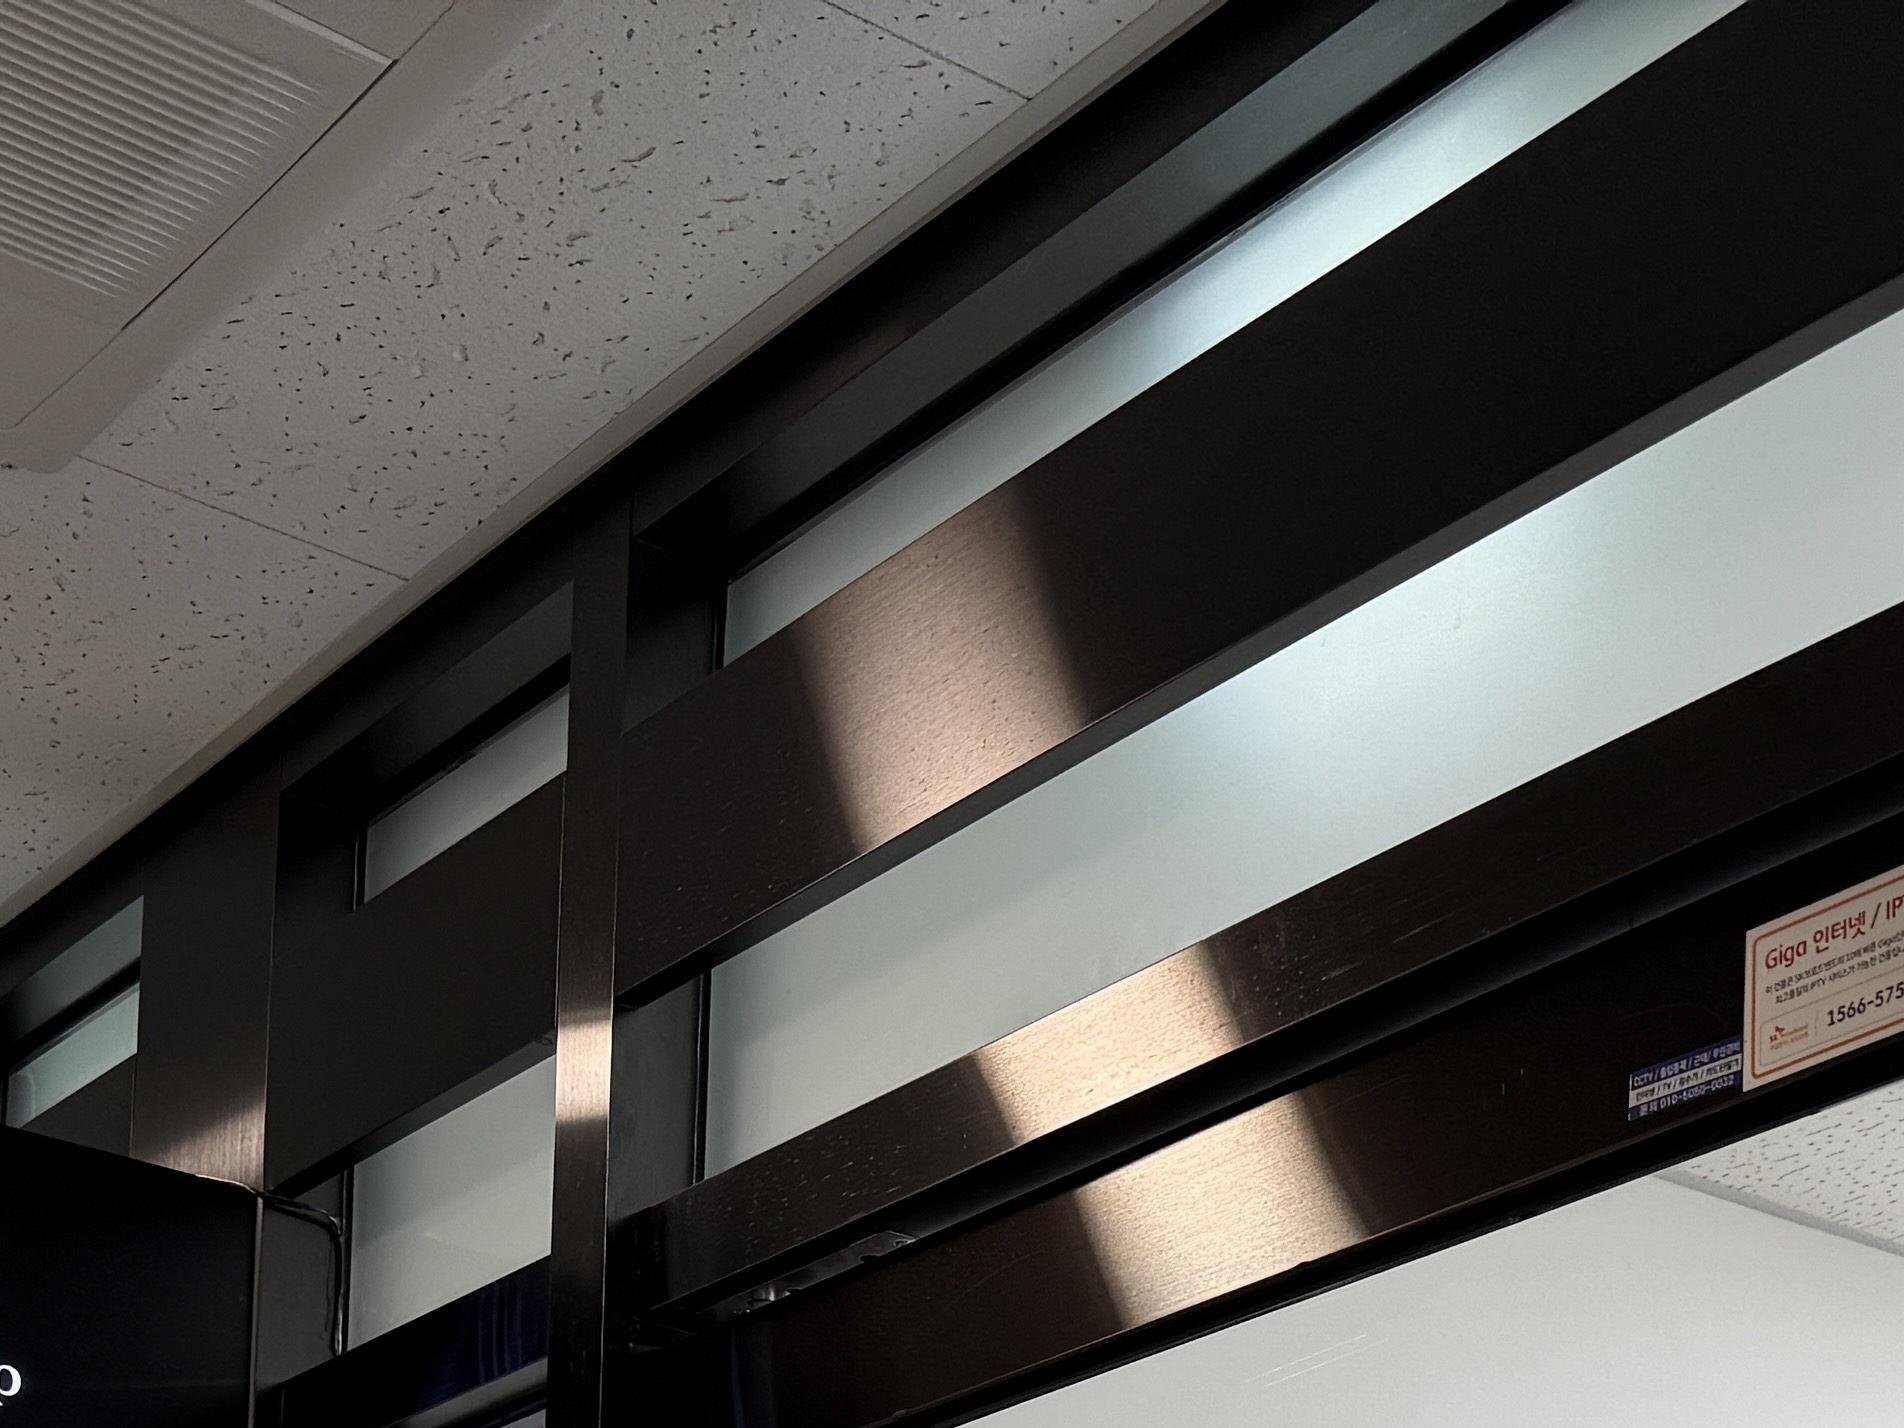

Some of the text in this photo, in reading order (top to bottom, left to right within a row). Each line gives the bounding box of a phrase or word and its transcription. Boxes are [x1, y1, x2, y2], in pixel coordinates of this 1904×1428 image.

[1765, 940, 1807, 969] Giga
[1813, 911, 1866, 954] 인터넷
[1871, 902, 1881, 929] /
